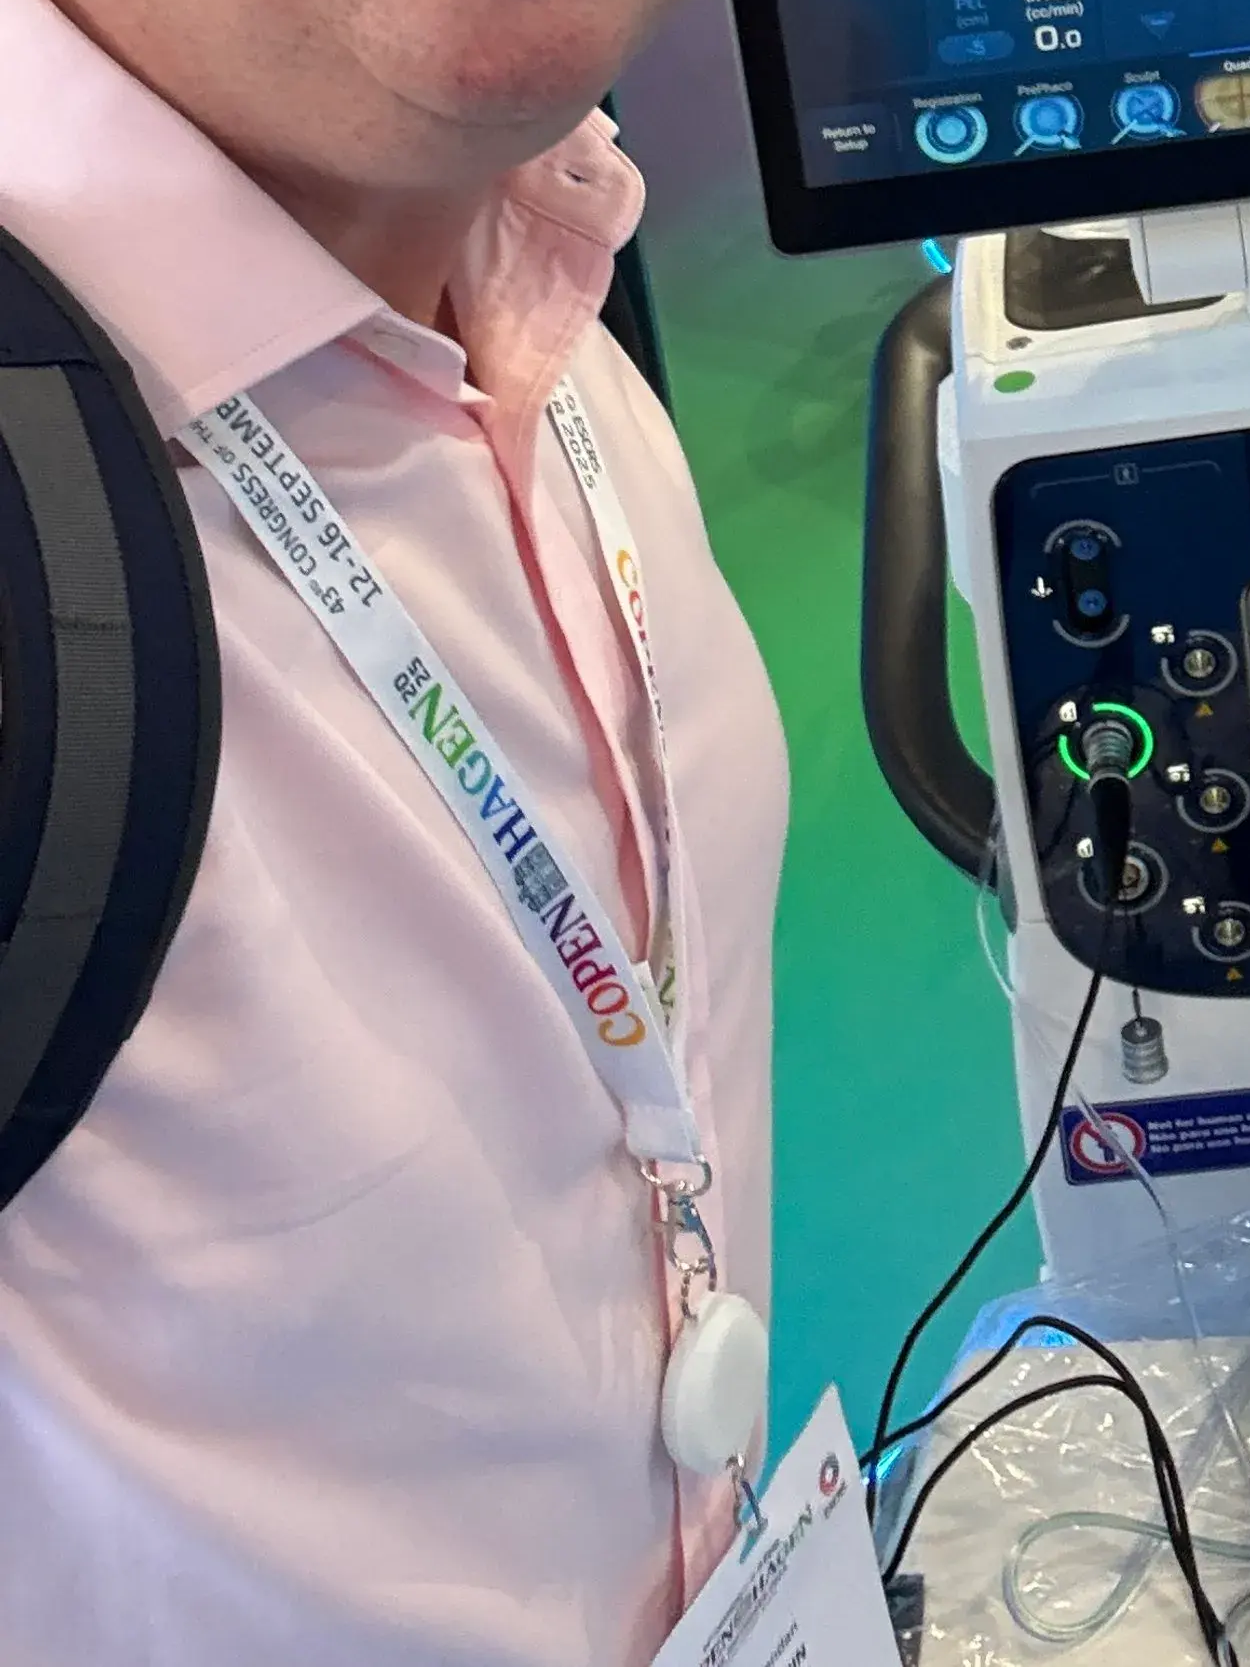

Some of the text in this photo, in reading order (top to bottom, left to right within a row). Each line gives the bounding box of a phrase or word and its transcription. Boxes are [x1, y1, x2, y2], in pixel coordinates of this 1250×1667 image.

[1034, 25, 1082, 51] 0.0
[213, 444, 236, 464] OF
[561, 423, 597, 490] 2025
[231, 463, 317, 576] CONGRESS
